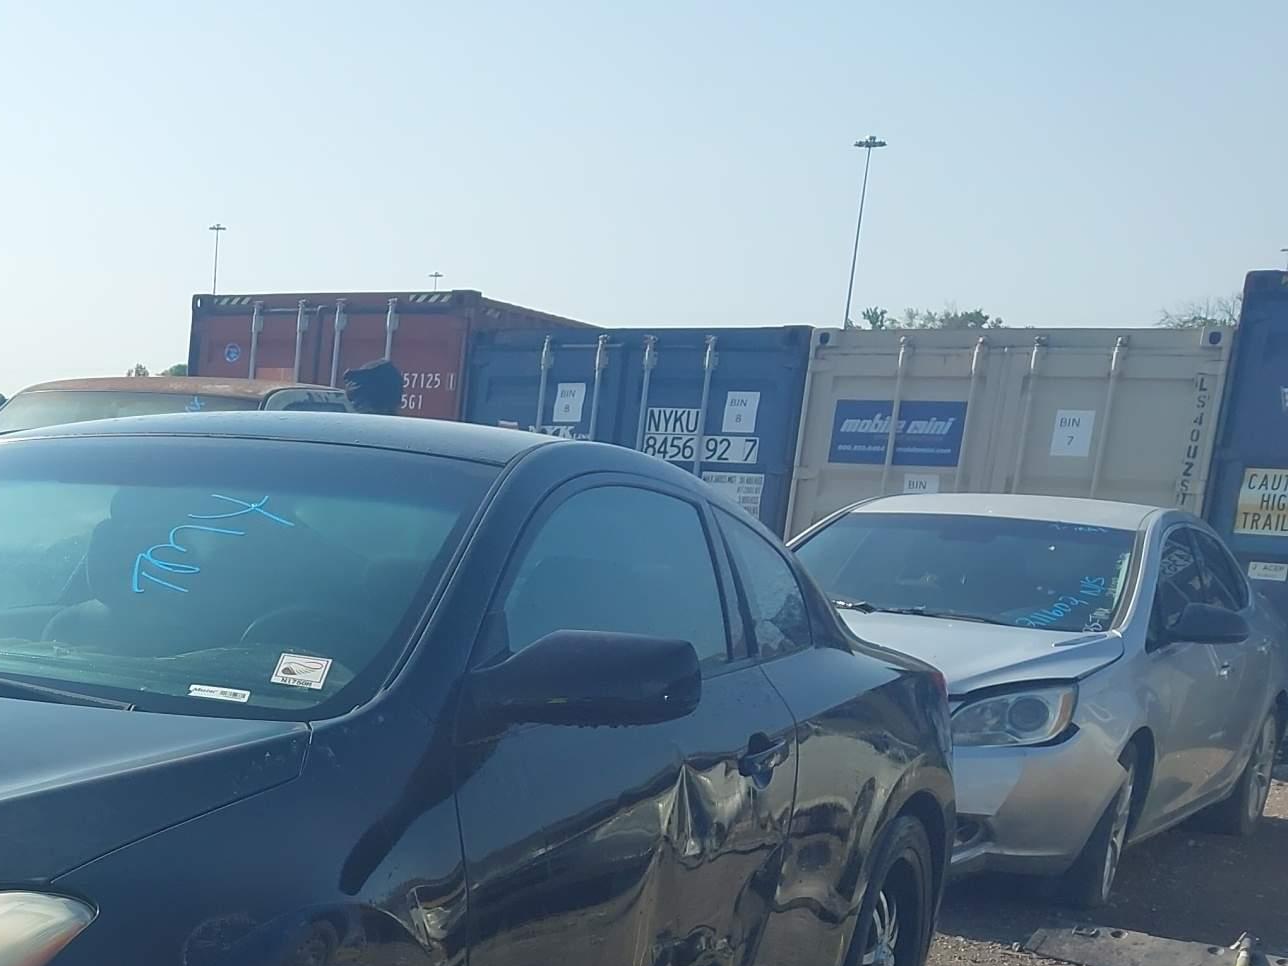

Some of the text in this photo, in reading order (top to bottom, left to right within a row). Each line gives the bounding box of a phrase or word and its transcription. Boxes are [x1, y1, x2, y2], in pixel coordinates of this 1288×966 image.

[560, 389, 577, 399] BIN
[729, 398, 748, 407] BIN
[647, 408, 700, 433] NYKU
[1059, 417, 1081, 428] BIN
[1066, 435, 1075, 446] 7
[743, 438, 758, 462] 7
[908, 479, 927, 490] BIN
[1241, 511, 1288, 532] TRAIL
